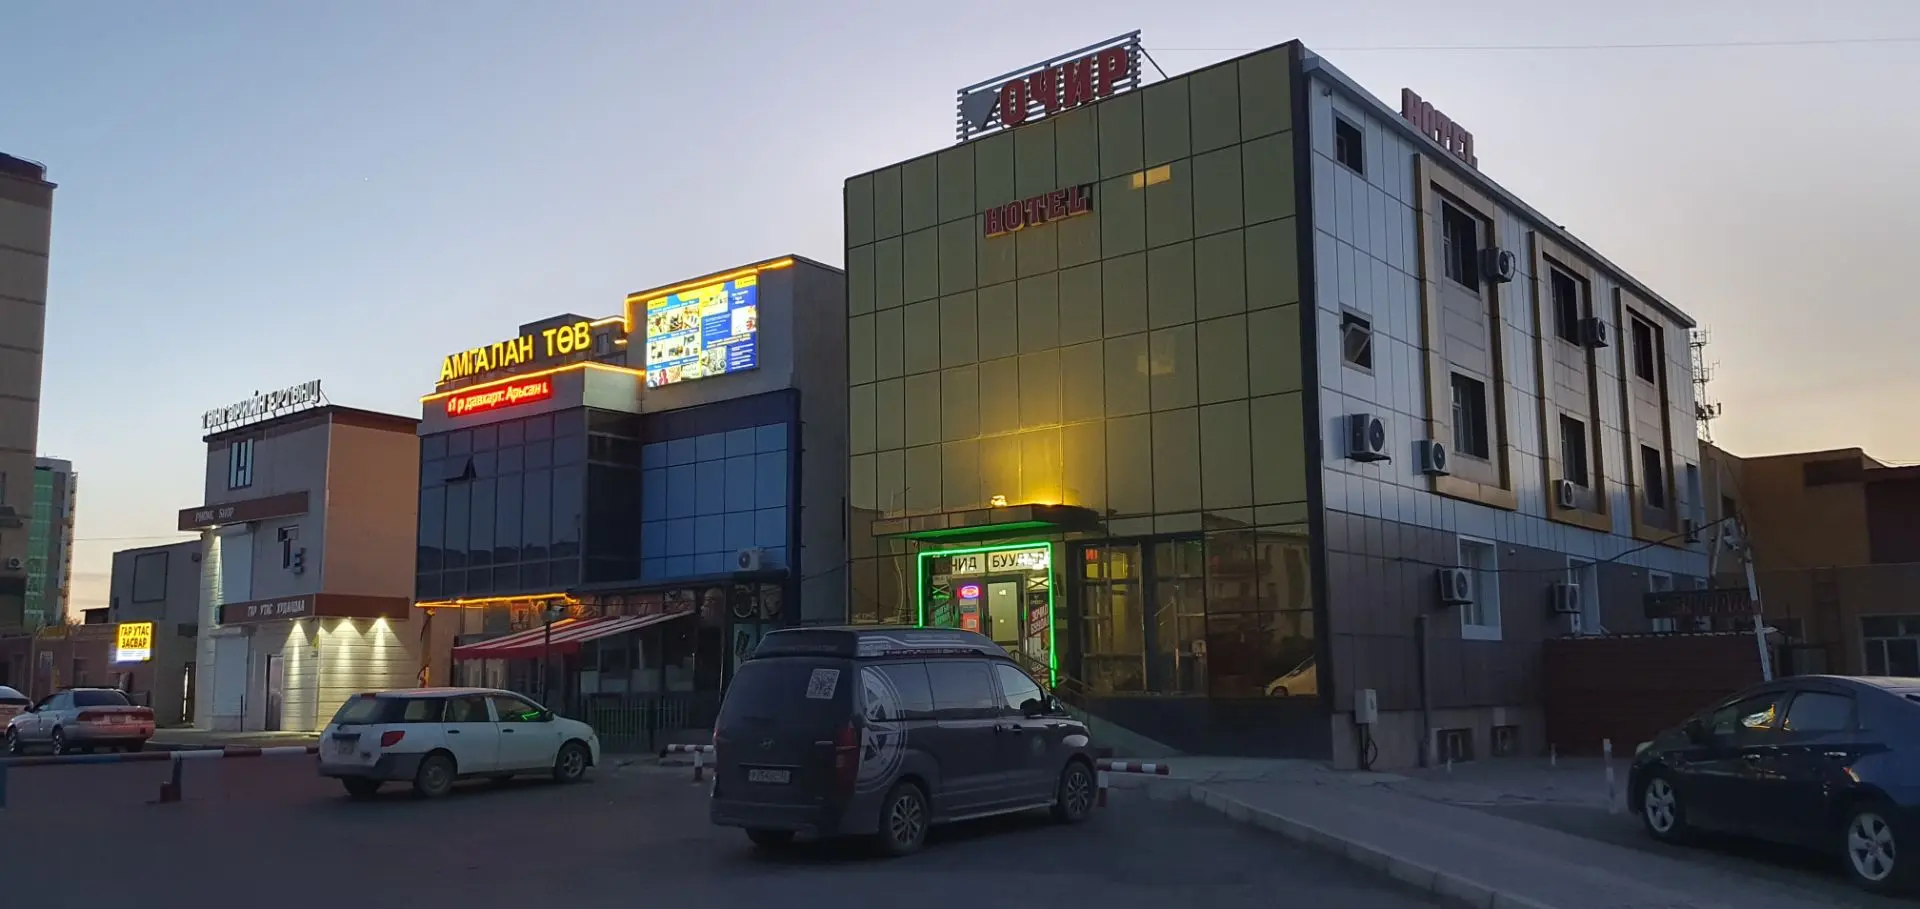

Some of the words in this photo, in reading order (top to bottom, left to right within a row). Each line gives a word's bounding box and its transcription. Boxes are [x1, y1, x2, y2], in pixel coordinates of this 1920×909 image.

[1000, 46, 1129, 128] ОЧИР
[1402, 88, 1478, 169] HOTEL
[984, 184, 1092, 238] HOTEL
[440, 335, 533, 381] АМГАЛАН
[542, 321, 591, 357] ТӨВ
[505, 383, 541, 403] Арьсан
[121, 627, 133, 637] ГАР
[133, 626, 150, 636] УТАС
[122, 637, 147, 649] ЗАСВАР
